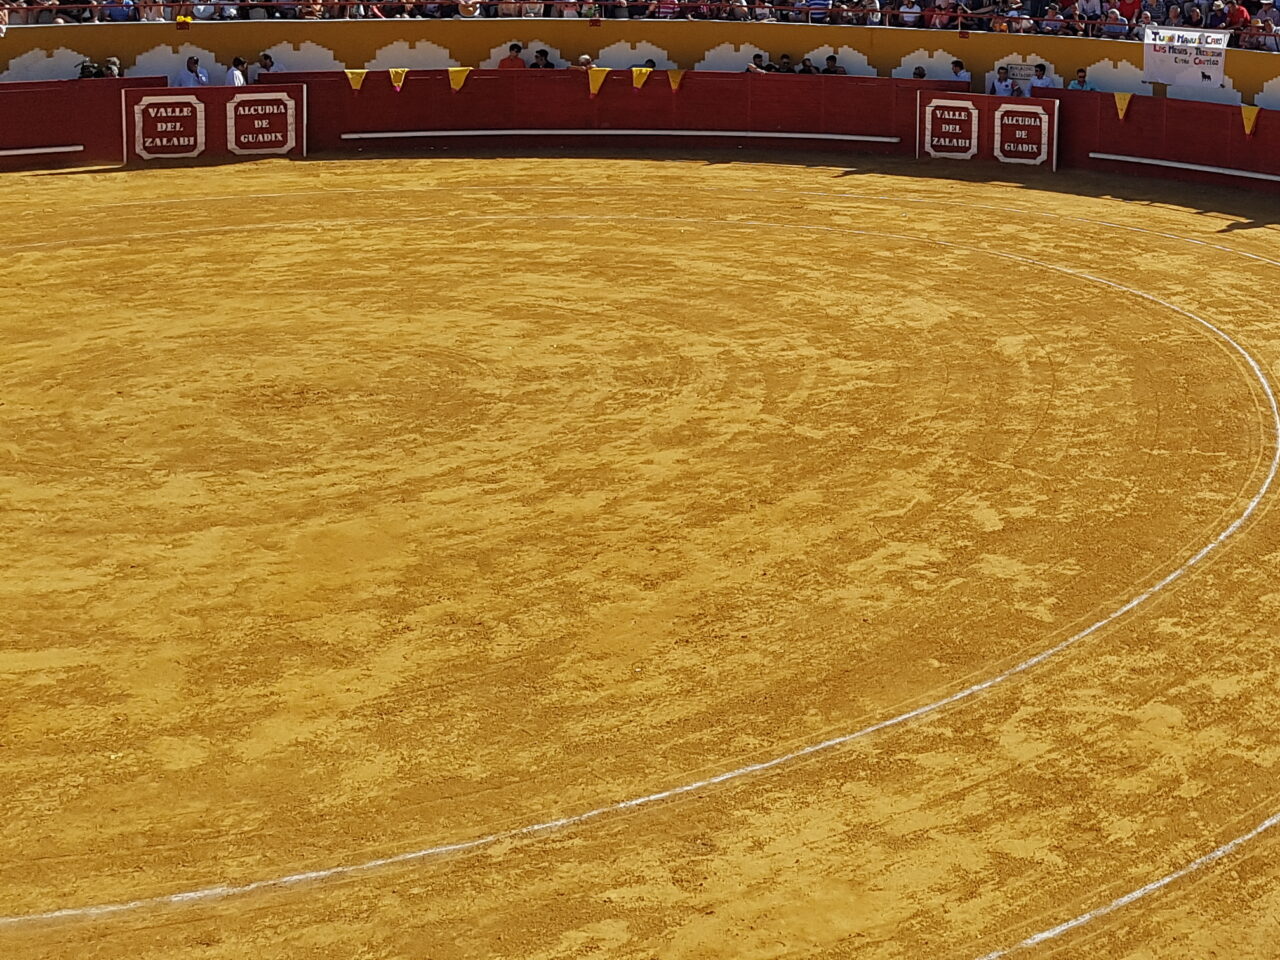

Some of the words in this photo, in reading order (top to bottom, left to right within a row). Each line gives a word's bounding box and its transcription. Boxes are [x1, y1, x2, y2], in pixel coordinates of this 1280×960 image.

[148, 107, 192, 118] VALLE
[236, 104, 286, 116] ALCUDIA
[935, 110, 968, 120] VALLE
[253, 119, 270, 129] DE
[1002, 116, 1041, 126] ALCUDIA
[156, 122, 184, 132] DEL
[941, 124, 962, 133] DEL
[240, 132, 283, 143] GUADIX
[1015, 130, 1028, 139] DE
[1004, 142, 1038, 153] GUADIX
